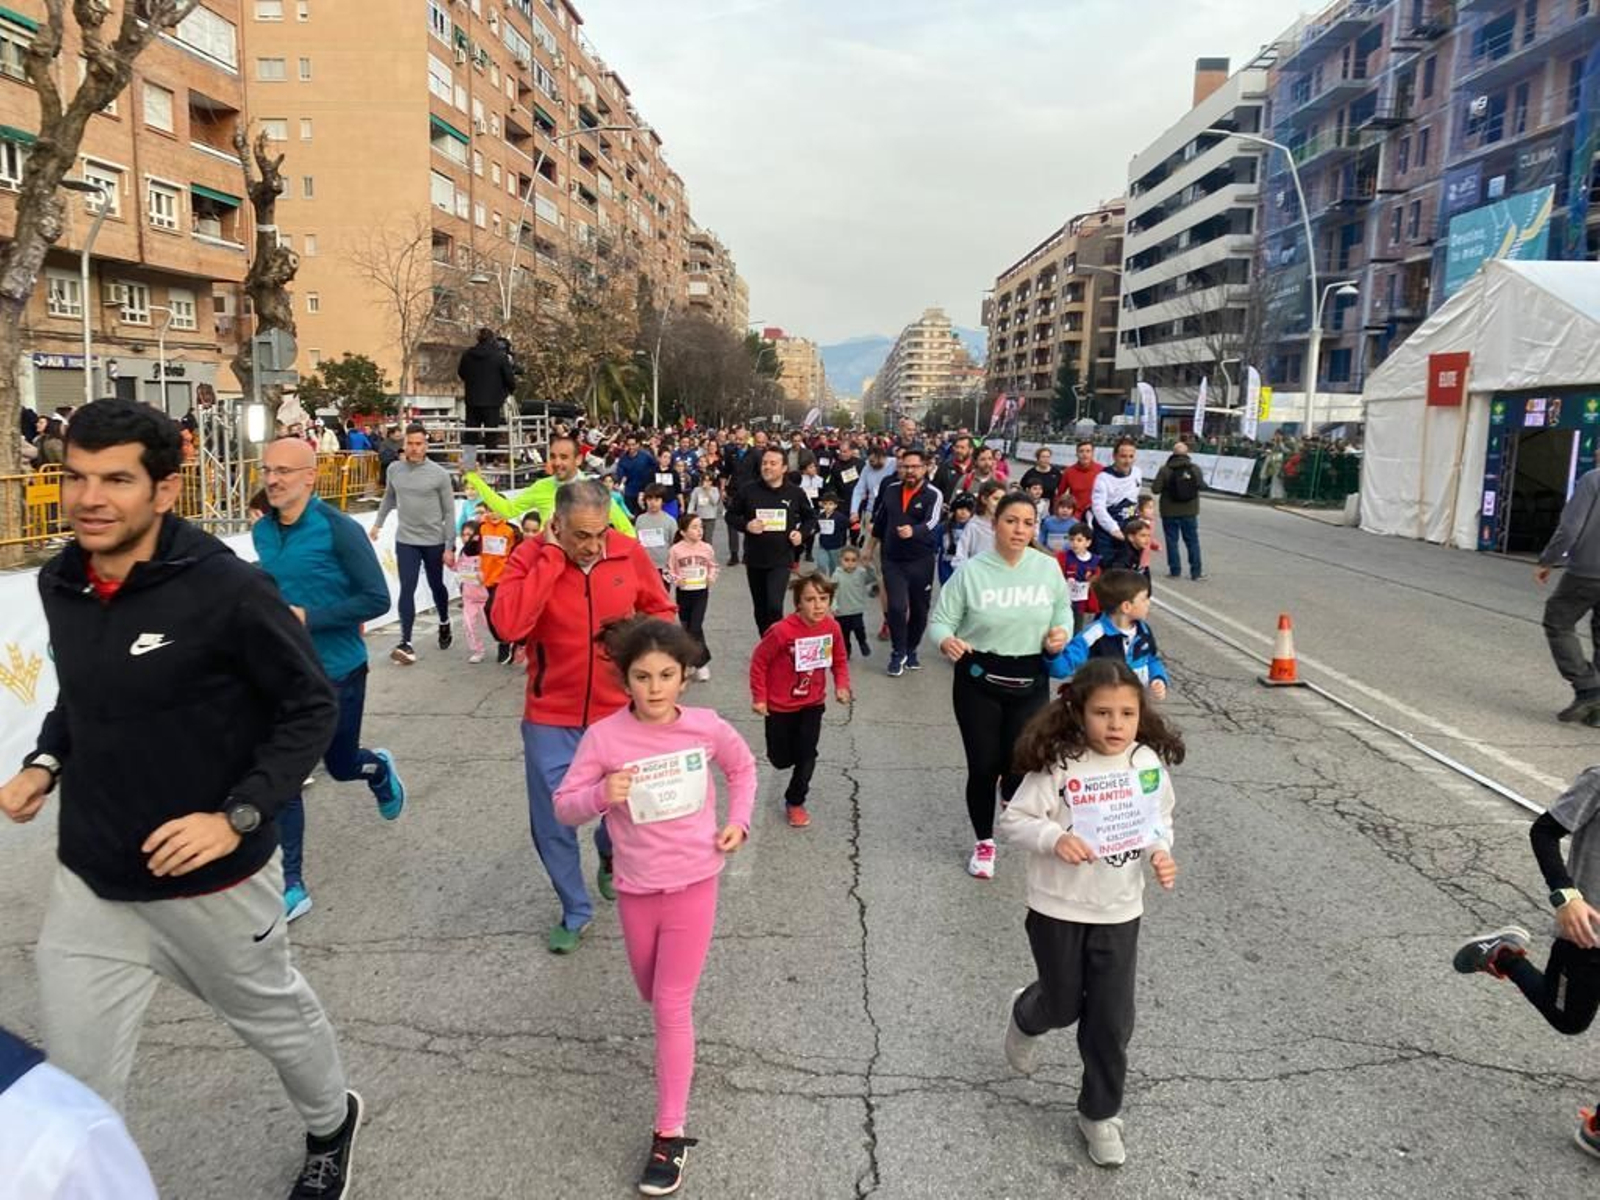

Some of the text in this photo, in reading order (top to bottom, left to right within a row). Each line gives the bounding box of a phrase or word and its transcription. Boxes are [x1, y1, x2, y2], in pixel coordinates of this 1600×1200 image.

[980, 584, 1051, 609] PUMA
[643, 761, 668, 773] NOCHE
[1084, 778, 1130, 792] NOCHE DE
[1072, 792, 1097, 806] SAN
[1109, 801, 1134, 812] ELENA
